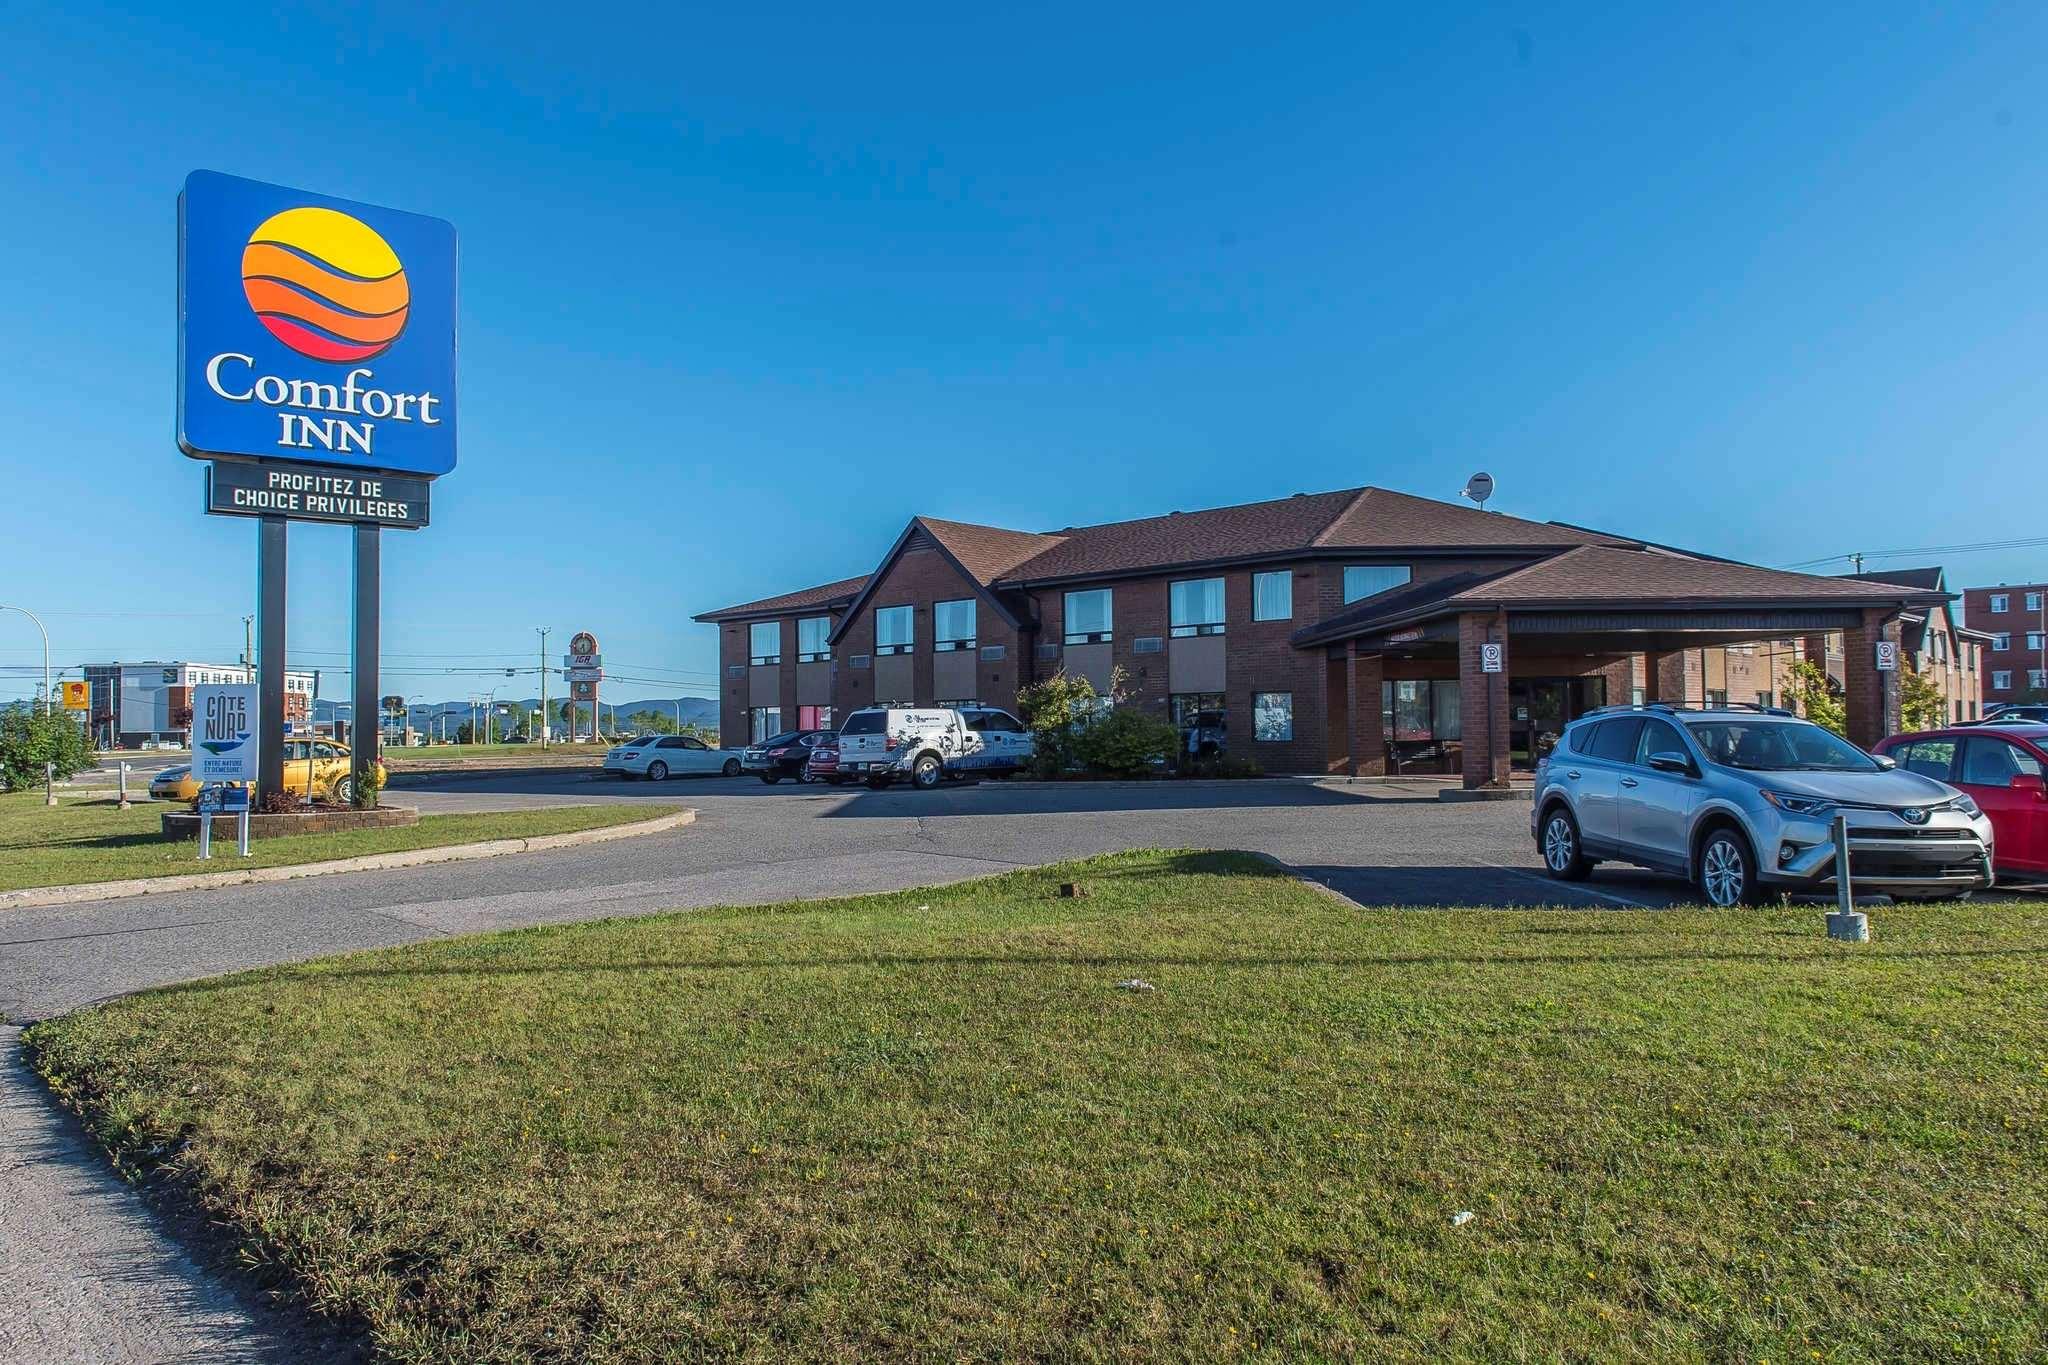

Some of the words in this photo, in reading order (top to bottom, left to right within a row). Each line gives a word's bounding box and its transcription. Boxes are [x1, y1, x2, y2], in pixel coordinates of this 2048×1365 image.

[206, 352, 440, 423] Comfort
[278, 412, 374, 454] INN
[269, 472, 354, 495] PROFITEZ
[361, 481, 382, 498] DE
[234, 489, 299, 510] CHOICE
[306, 495, 408, 519] PRIVILEGES
[206, 691, 246, 717] CÔTE
[205, 712, 246, 740] NORD
